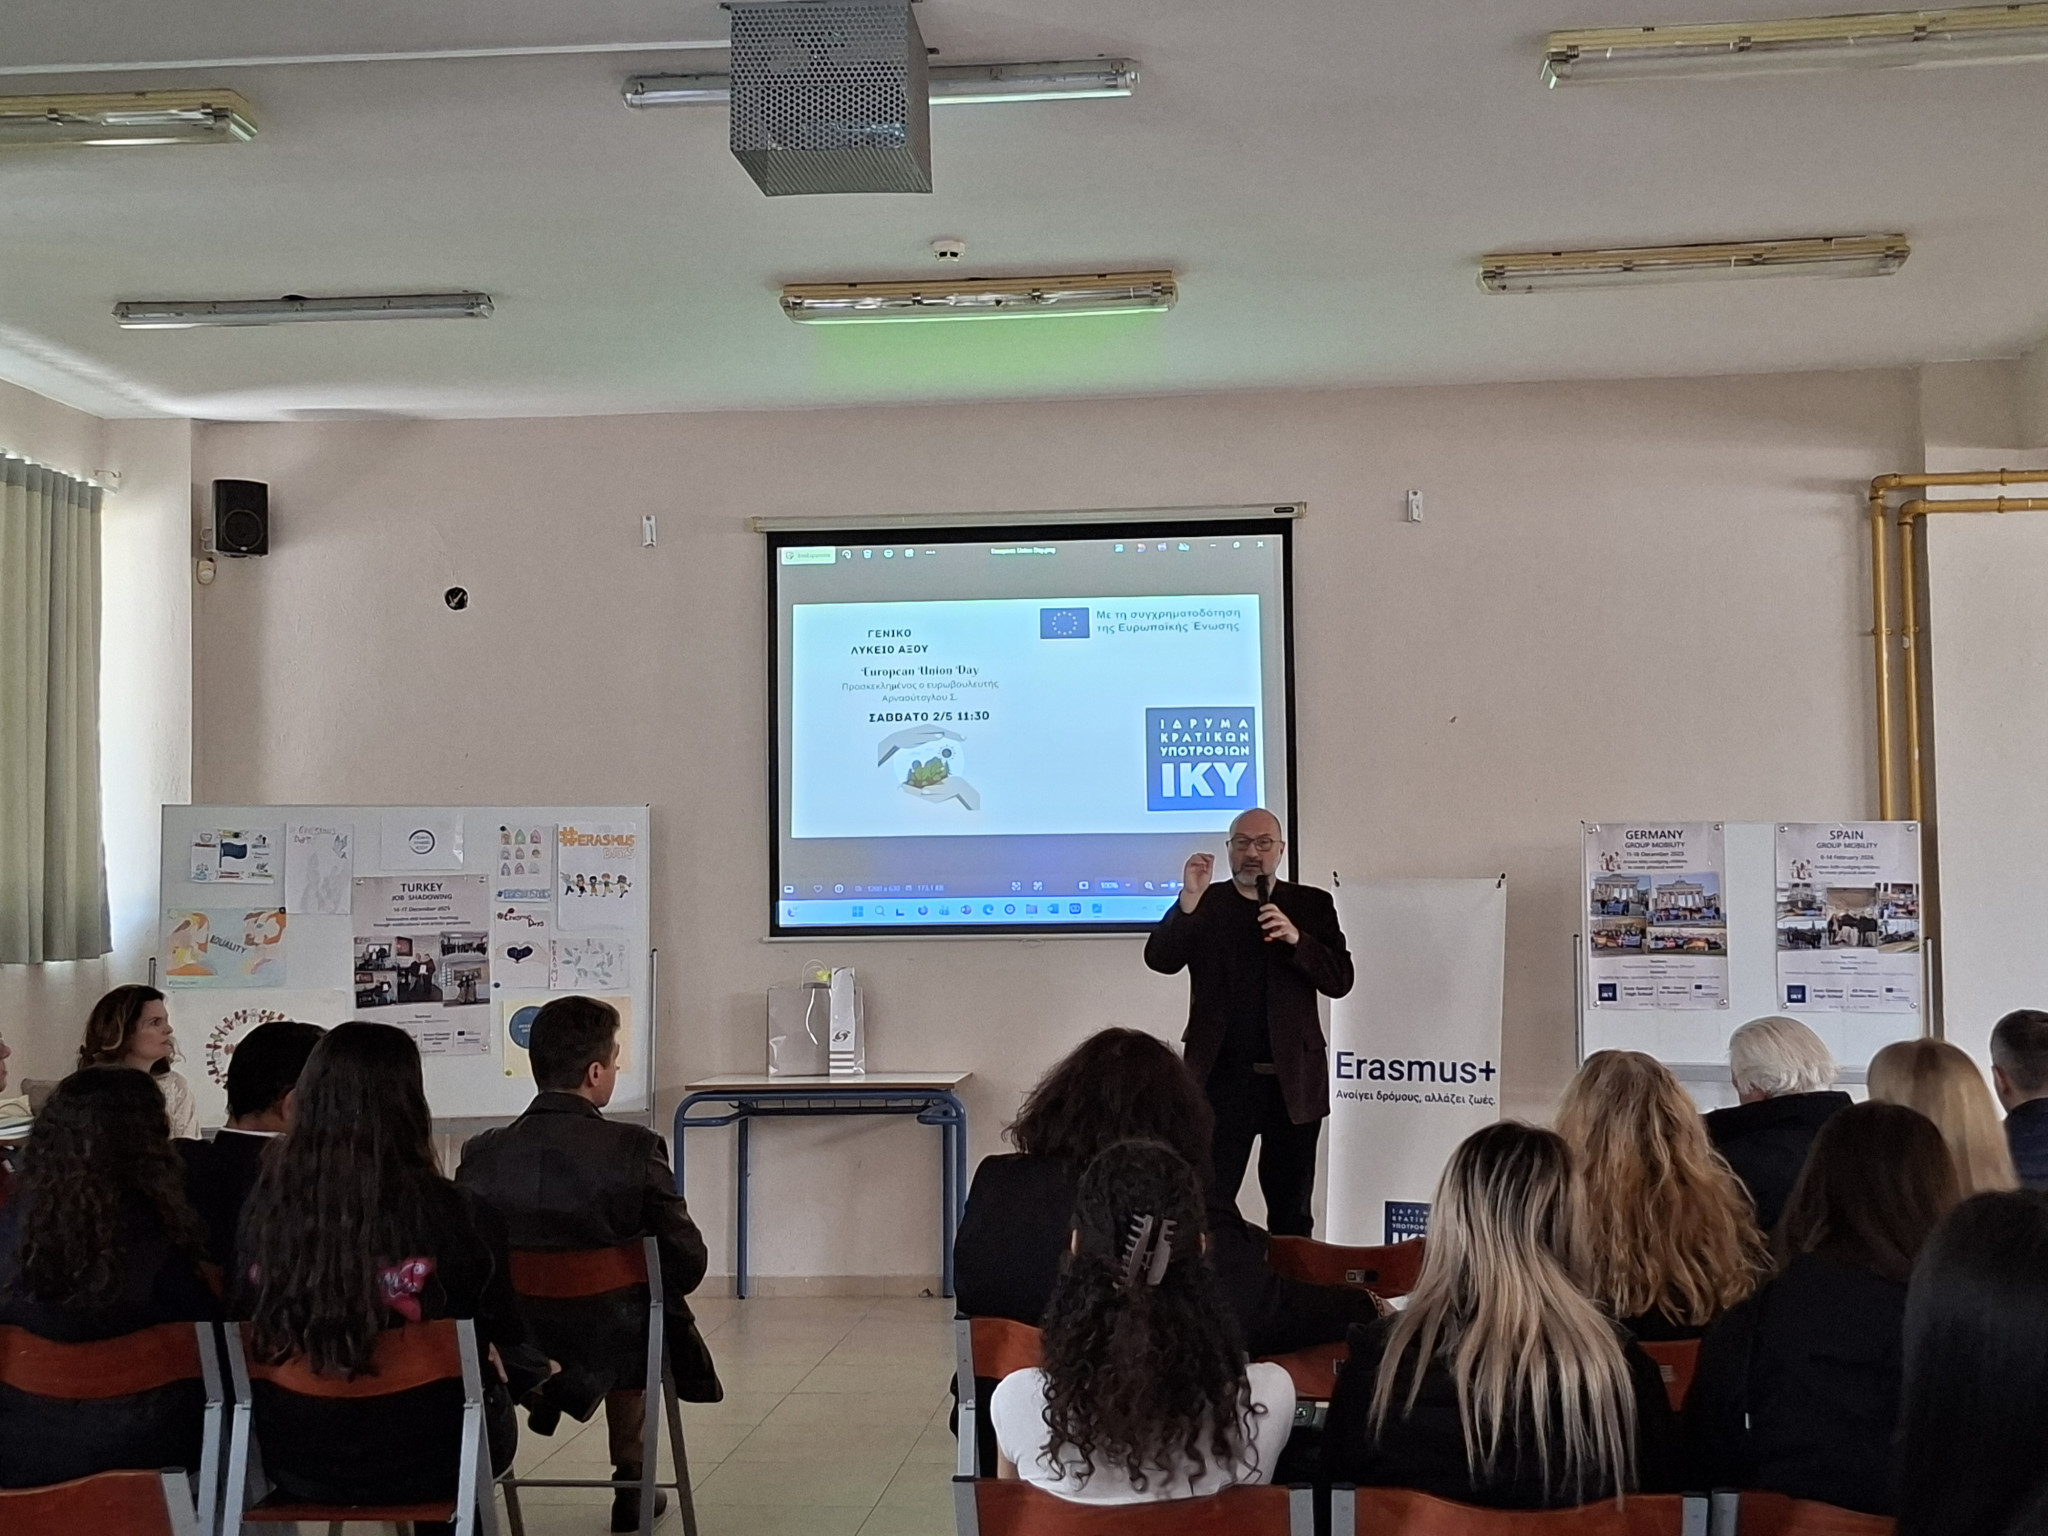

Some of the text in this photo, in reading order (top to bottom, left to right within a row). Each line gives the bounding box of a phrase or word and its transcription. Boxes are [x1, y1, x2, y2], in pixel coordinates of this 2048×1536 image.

[1096, 611, 1111, 619] Με
[1115, 612, 1127, 621] τη
[867, 629, 912, 638] ΓΕΝΙΚΟ
[1097, 624, 1115, 634] της
[851, 644, 929, 655] ΛΥΚΕΙΟ ΑΞΟΥ
[861, 664, 980, 679] European Union Day
[869, 710, 990, 723] ΣΑΒΒΑΤΟ 2/5 11:30
[1160, 718, 1249, 730] ΙΔΡΥΜΑ
[1160, 732, 1249, 743] ΚΡΑΤΙΚΩΝ
[1160, 746, 1250, 757] ΥΠΟΤΡΟΦΙΩΝ
[1161, 762, 1248, 798] ΙΚΥ
[1625, 829, 1684, 840] GERMANY
[1829, 829, 1864, 840] SPAIN
[1624, 841, 1651, 849] GROUP
[401, 882, 444, 892] TURKEY
[1336, 1051, 1496, 1083] Erasmus+
[1336, 1089, 1374, 1102] Ανοίγει
[1376, 1089, 1422, 1104] δρόμους,
[1424, 1092, 1466, 1104] αλλάζει
